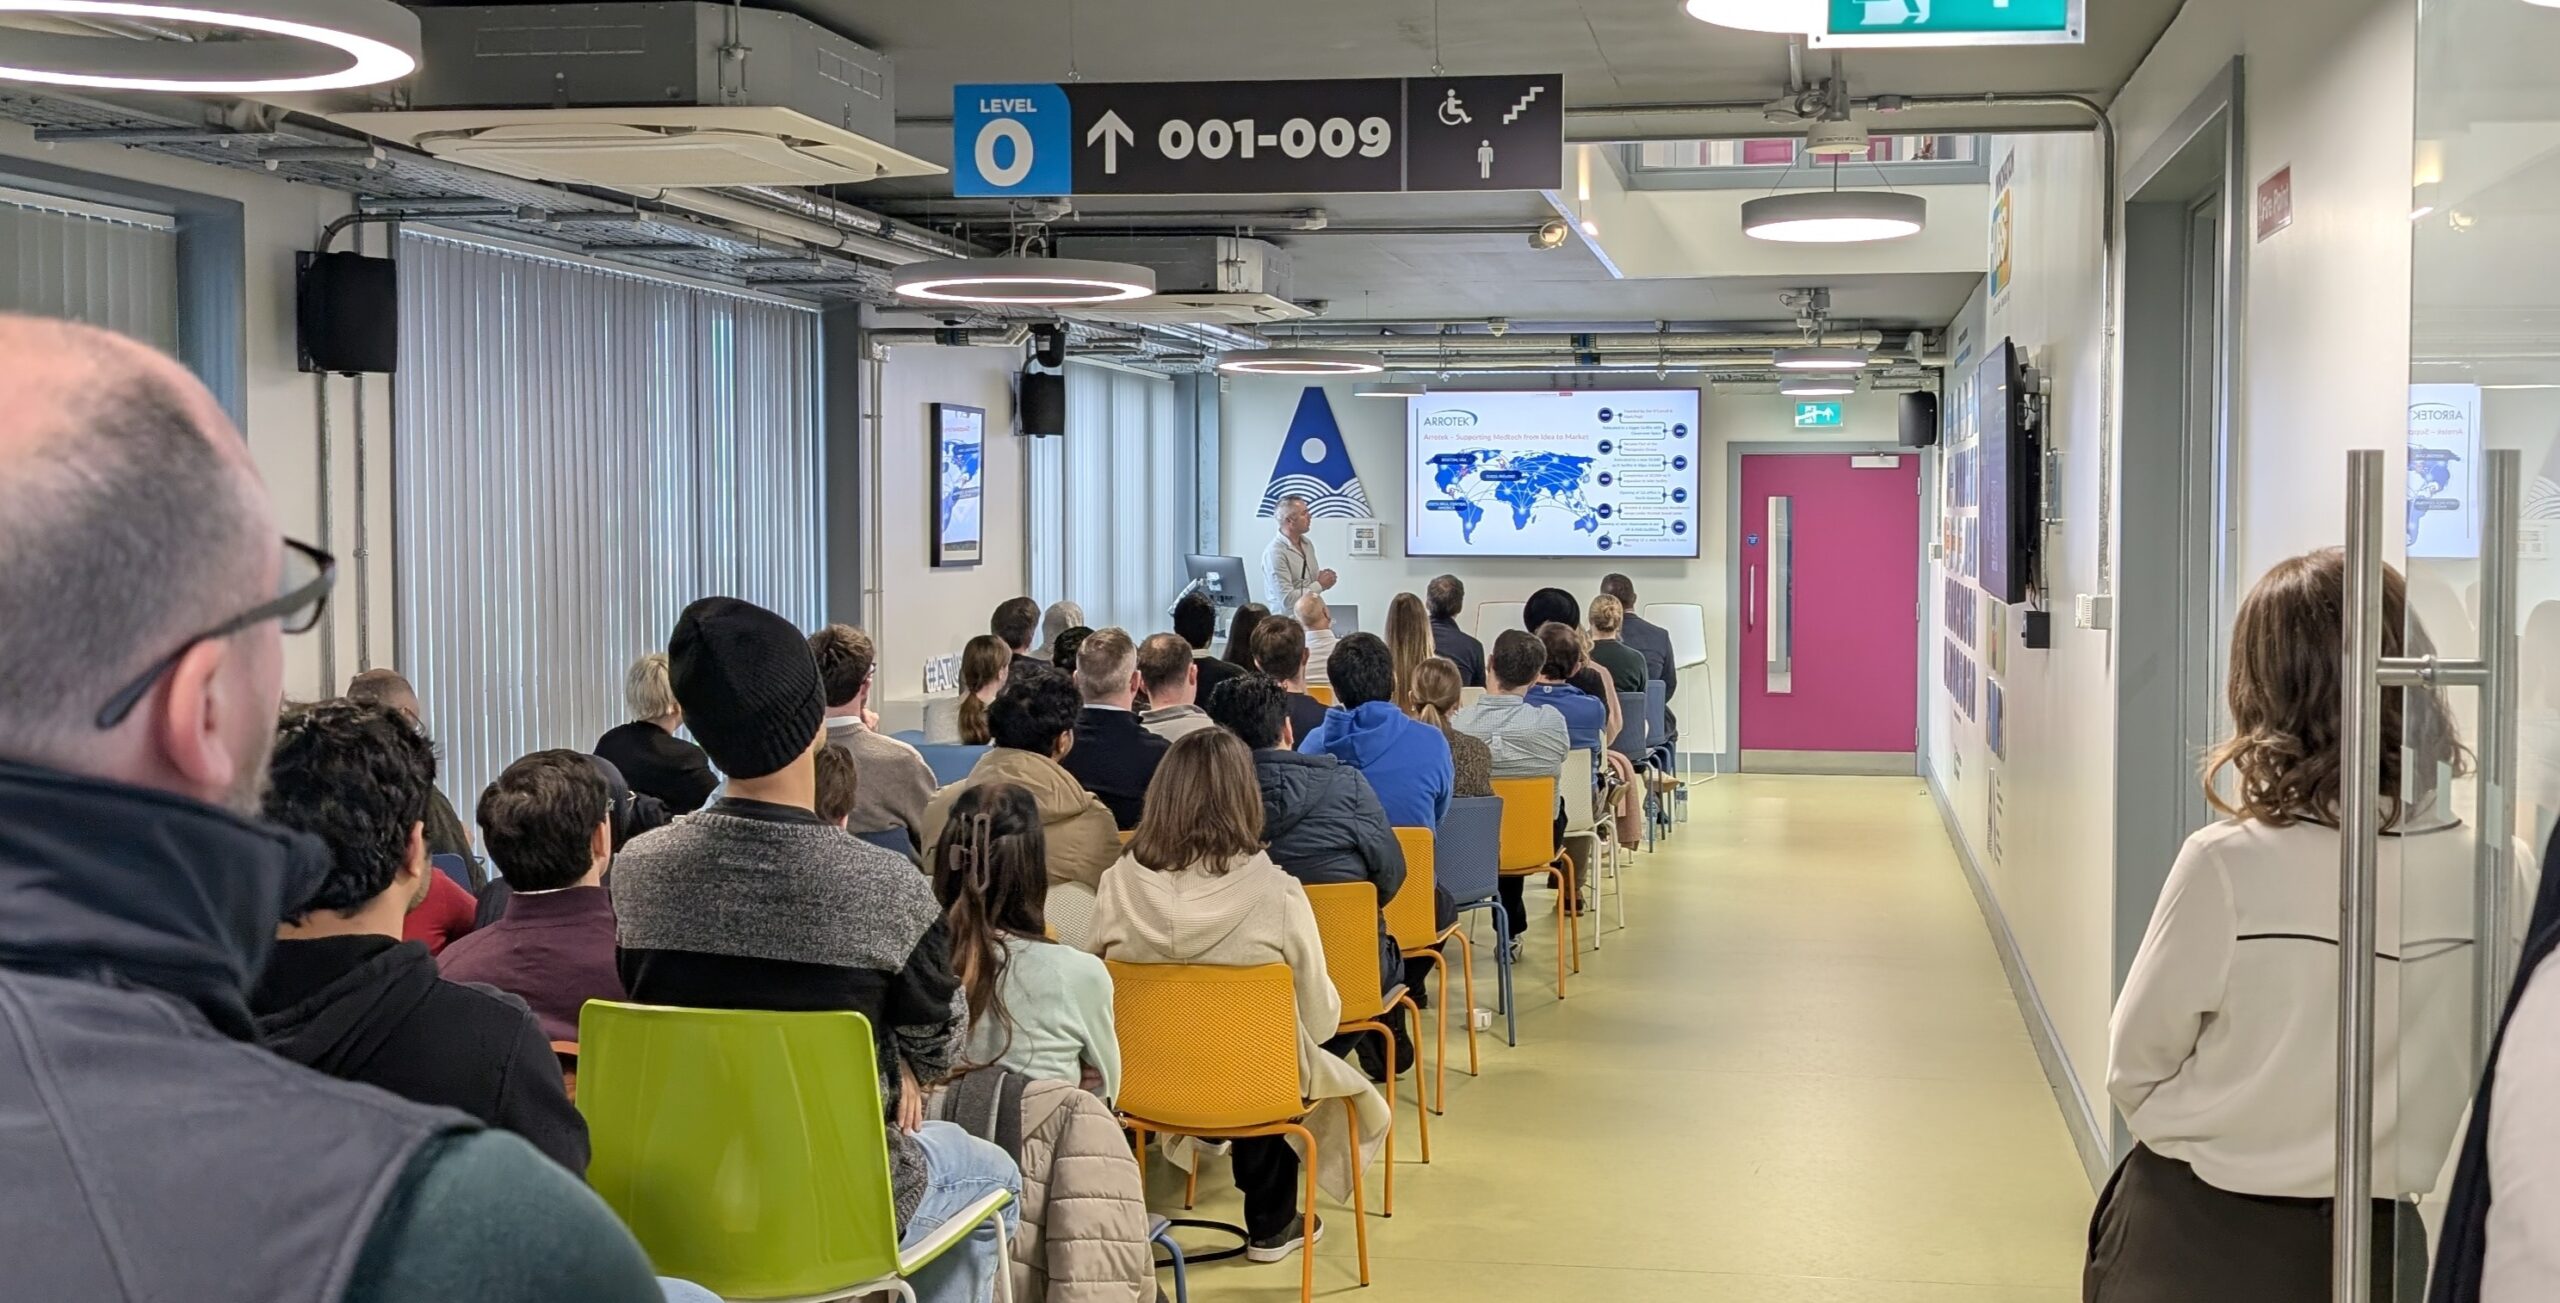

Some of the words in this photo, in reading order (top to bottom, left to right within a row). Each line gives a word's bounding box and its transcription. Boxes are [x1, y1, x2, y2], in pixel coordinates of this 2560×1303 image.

[979, 98, 1037, 113] LEVEL
[1157, 116, 1392, 160] 001-009
[1423, 416, 1470, 427] ARROTEK
[1423, 433, 1449, 441] Arrotek
[1455, 433, 1492, 442] Supporting
[1523, 433, 1540, 441] from
[1564, 433, 1590, 441] Market
